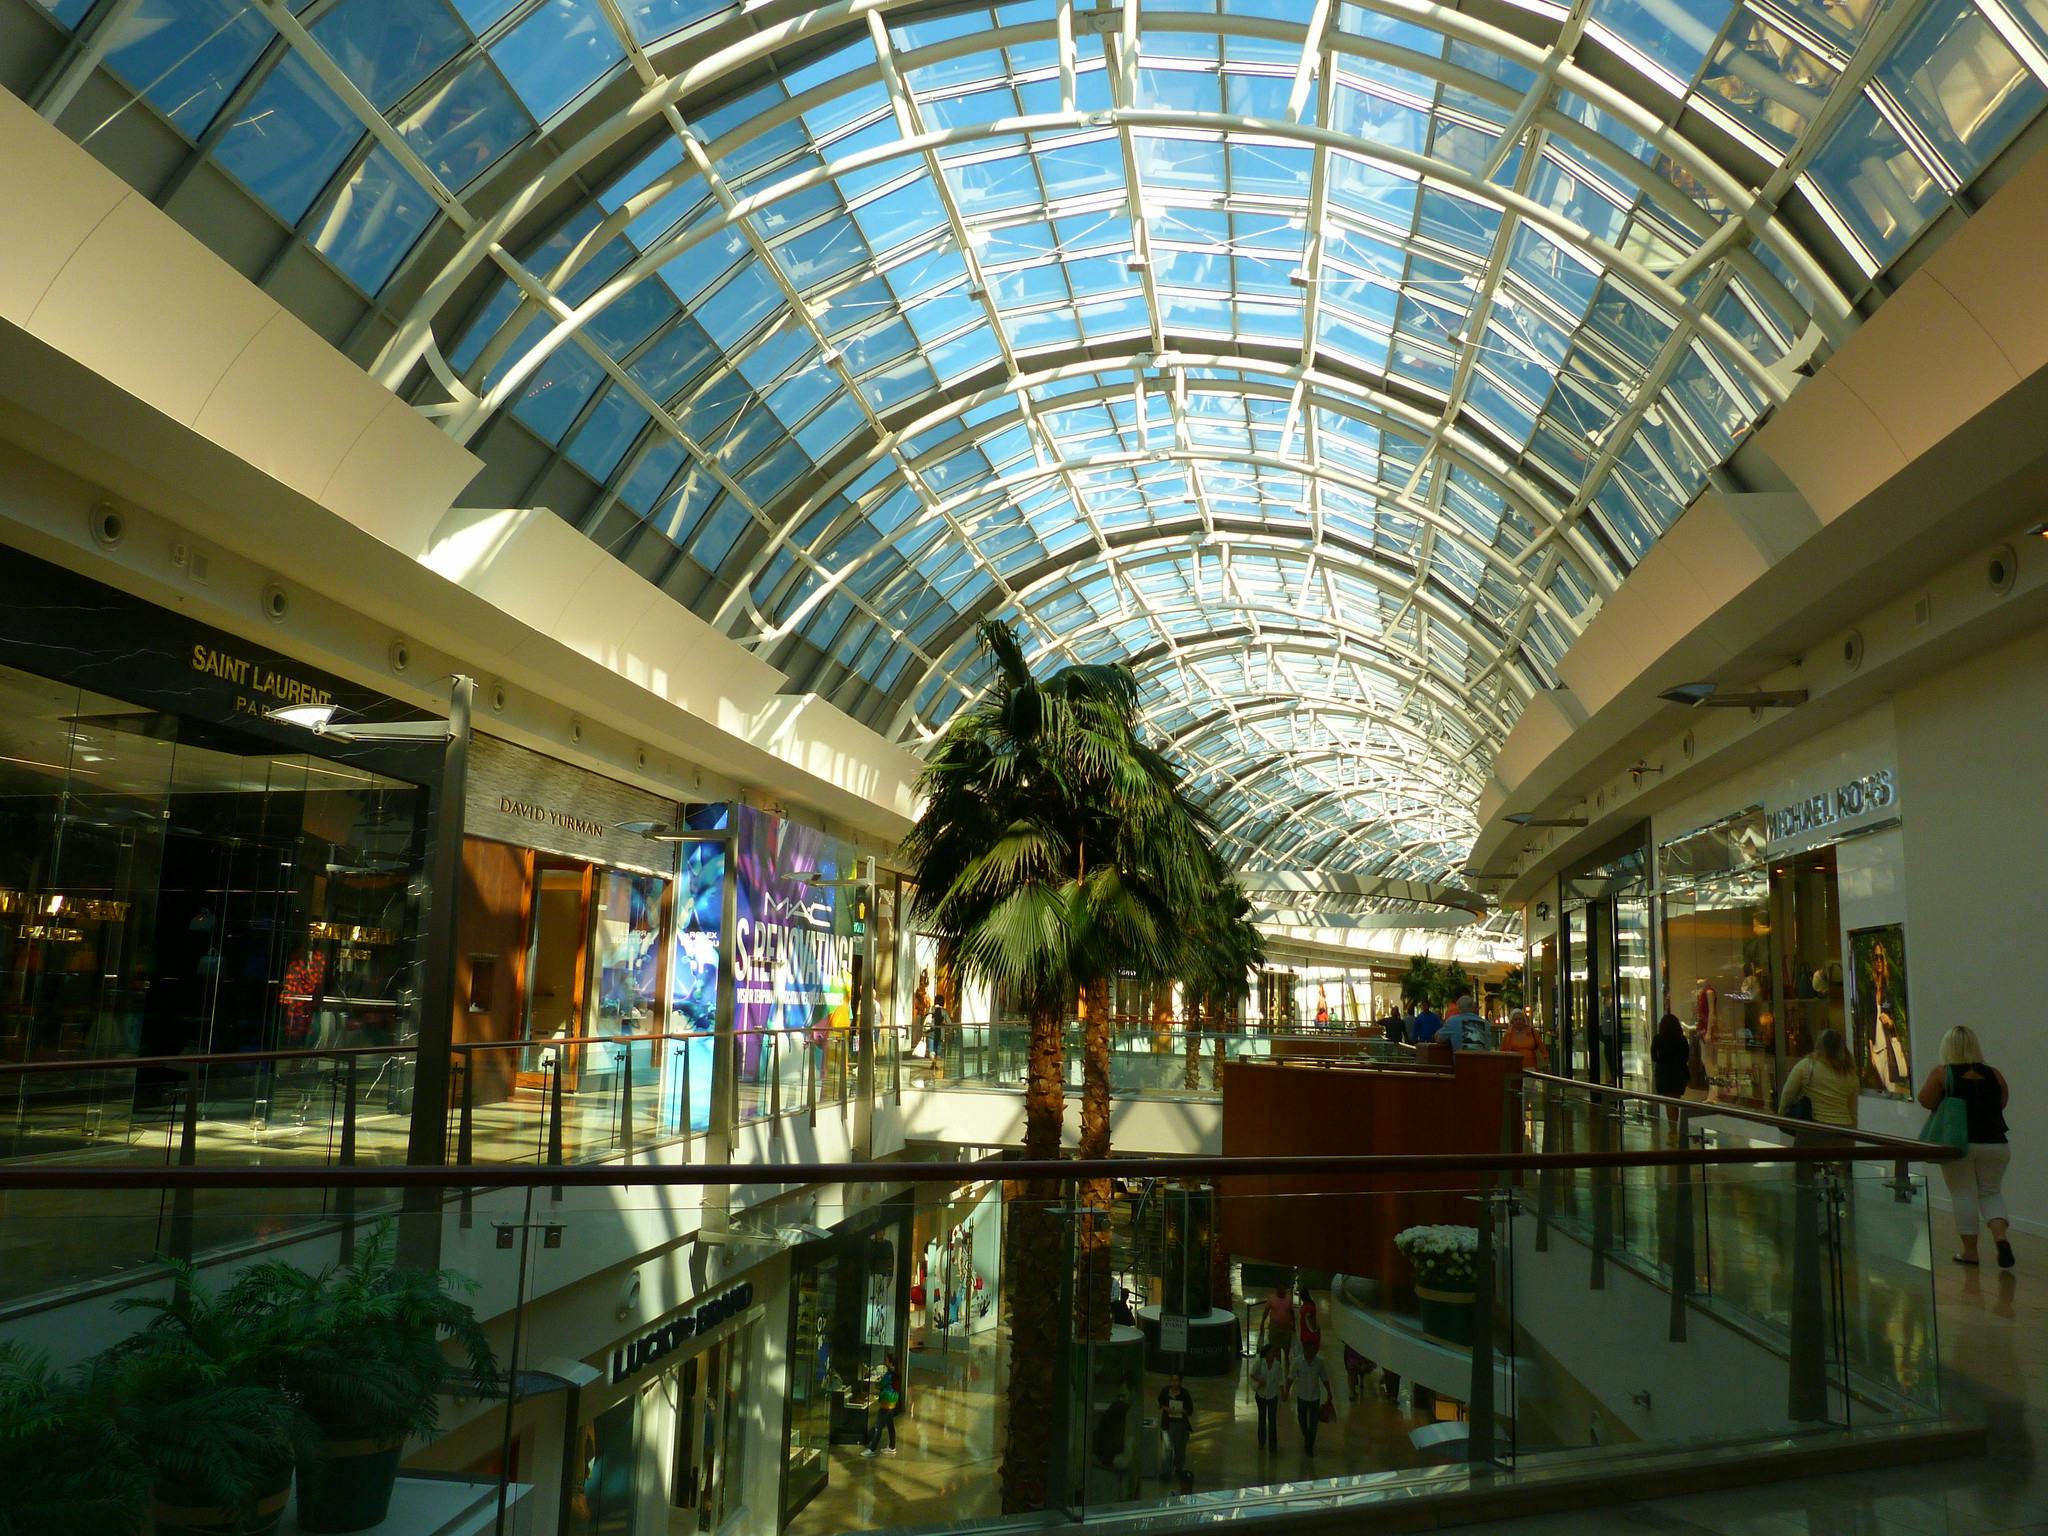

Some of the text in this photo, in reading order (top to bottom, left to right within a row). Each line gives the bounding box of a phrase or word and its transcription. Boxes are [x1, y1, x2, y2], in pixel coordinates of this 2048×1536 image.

[192, 644, 332, 705] SAINT LAURENT
[233, 695, 289, 727] PAR
[499, 797, 603, 837] DAVID YURMAN
[1765, 770, 1894, 841] MICHAEL KORS
[610, 1320, 689, 1385] LUCKY
